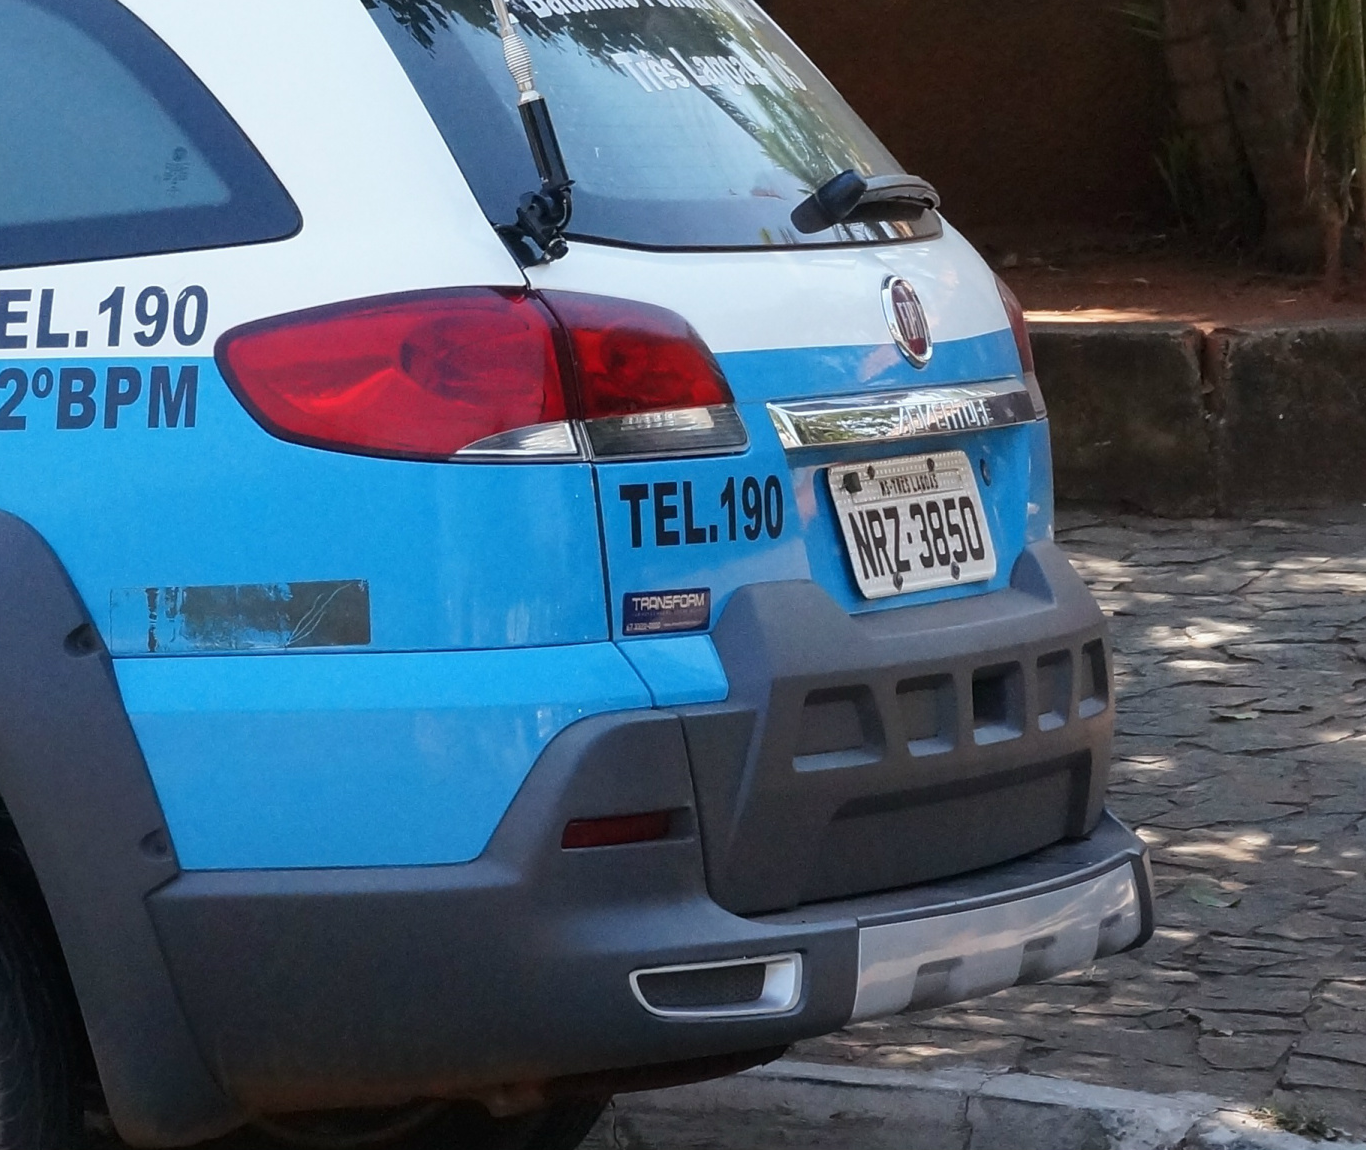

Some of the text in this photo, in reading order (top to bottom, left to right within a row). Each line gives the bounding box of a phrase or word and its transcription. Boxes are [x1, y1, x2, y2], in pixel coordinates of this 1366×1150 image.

[611, 47, 691, 93] Três
[619, 474, 784, 549] TEL.190
[632, 593, 705, 611] TRANSFORM
